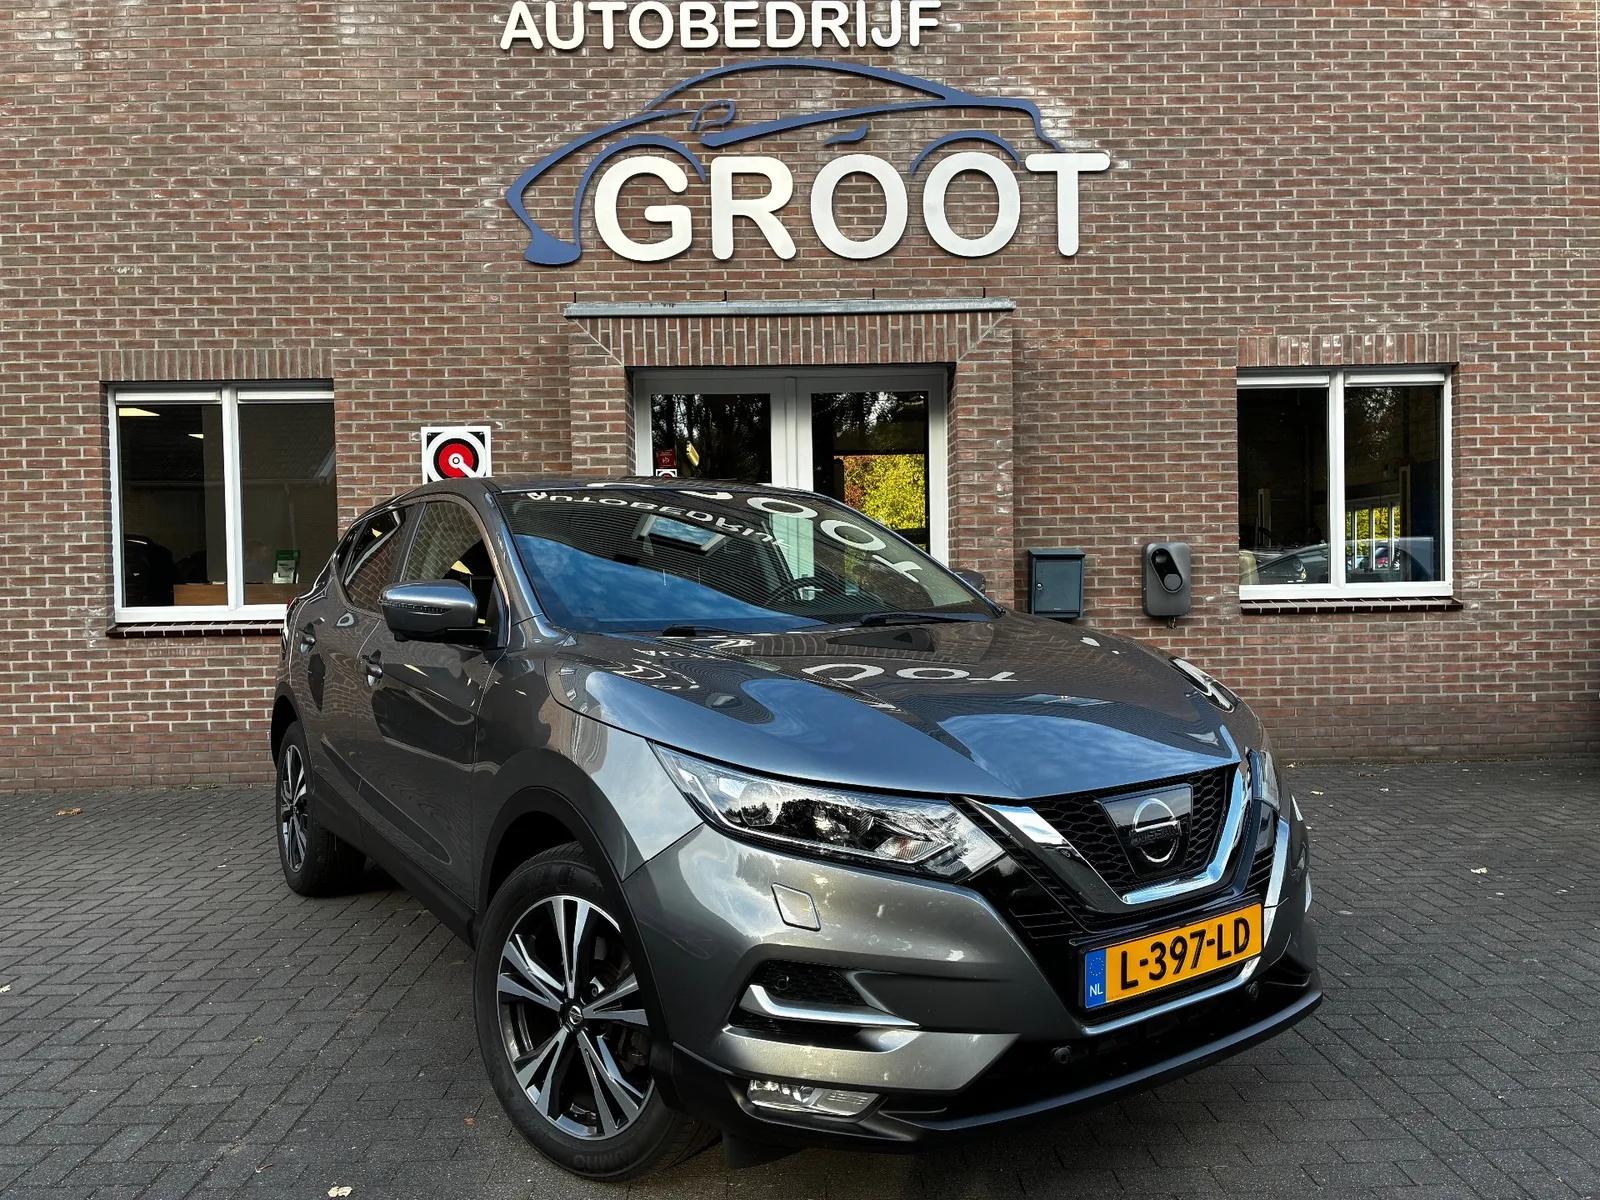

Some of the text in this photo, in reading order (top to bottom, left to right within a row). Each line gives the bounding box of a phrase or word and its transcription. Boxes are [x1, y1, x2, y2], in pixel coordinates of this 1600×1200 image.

[500, 0, 941, 50] AUTOBEDRIJF
[594, 152, 1110, 261] GROOT
[1120, 916, 1250, 990] L-397-LD
[1089, 983, 1104, 998] NL
